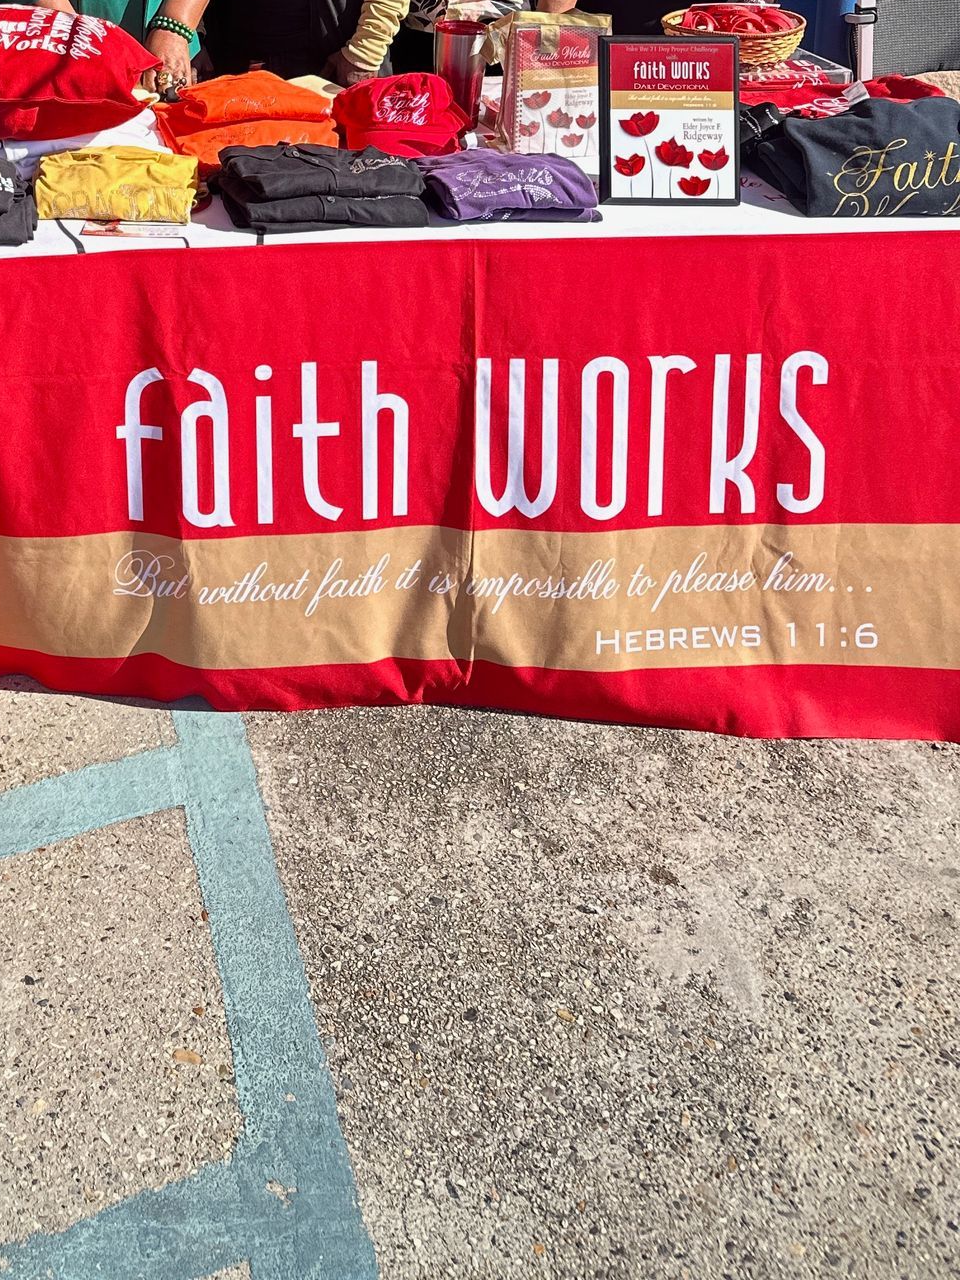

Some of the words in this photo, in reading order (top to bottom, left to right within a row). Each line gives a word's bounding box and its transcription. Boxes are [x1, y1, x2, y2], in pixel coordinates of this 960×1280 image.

[561, 45, 591, 60] Works
[633, 61, 666, 80] faith
[670, 61, 710, 80] works
[682, 122, 698, 130] Elder
[698, 122, 715, 132] Joyce
[683, 130, 724, 143] Ridgeway
[833, 139, 960, 197] Fait
[116, 360, 409, 528] faith
[475, 351, 829, 520] works
[113, 550, 188, 600] But
[198, 562, 310, 605] without
[305, 553, 390, 617] faith
[394, 559, 422, 591] it
[428, 569, 457, 594] is
[466, 559, 619, 614] impossible
[627, 564, 656, 593] to
[650, 552, 756, 613] please
[595, 624, 761, 655] HEBREWS
[786, 623, 879, 650] 11:6
